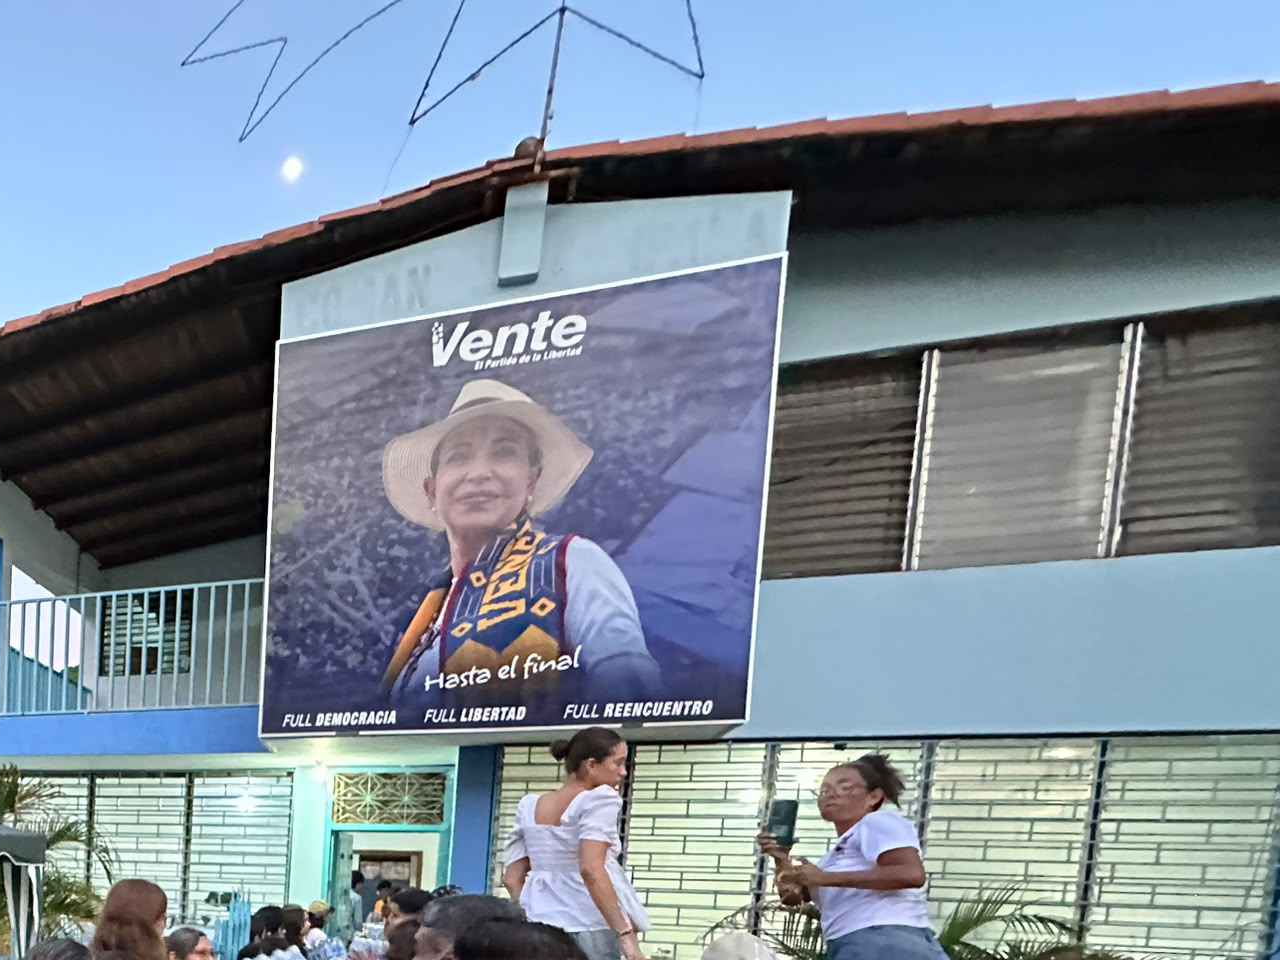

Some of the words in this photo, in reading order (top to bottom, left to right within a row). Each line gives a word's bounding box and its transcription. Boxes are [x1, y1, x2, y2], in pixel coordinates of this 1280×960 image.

[431, 310, 587, 367] Vente
[484, 356, 517, 369] Partido
[518, 354, 531, 364] de
[543, 345, 583, 360] Libertad
[424, 666, 491, 691] Hasta
[498, 655, 519, 679] el
[523, 645, 582, 679] final
[282, 713, 312, 727] FULL
[315, 710, 397, 726] DEMOCRACIA
[424, 708, 456, 723] FULL
[460, 706, 526, 722] LIBERTAD
[563, 703, 599, 719] FULL
[603, 700, 713, 718] REENCUENTRO
